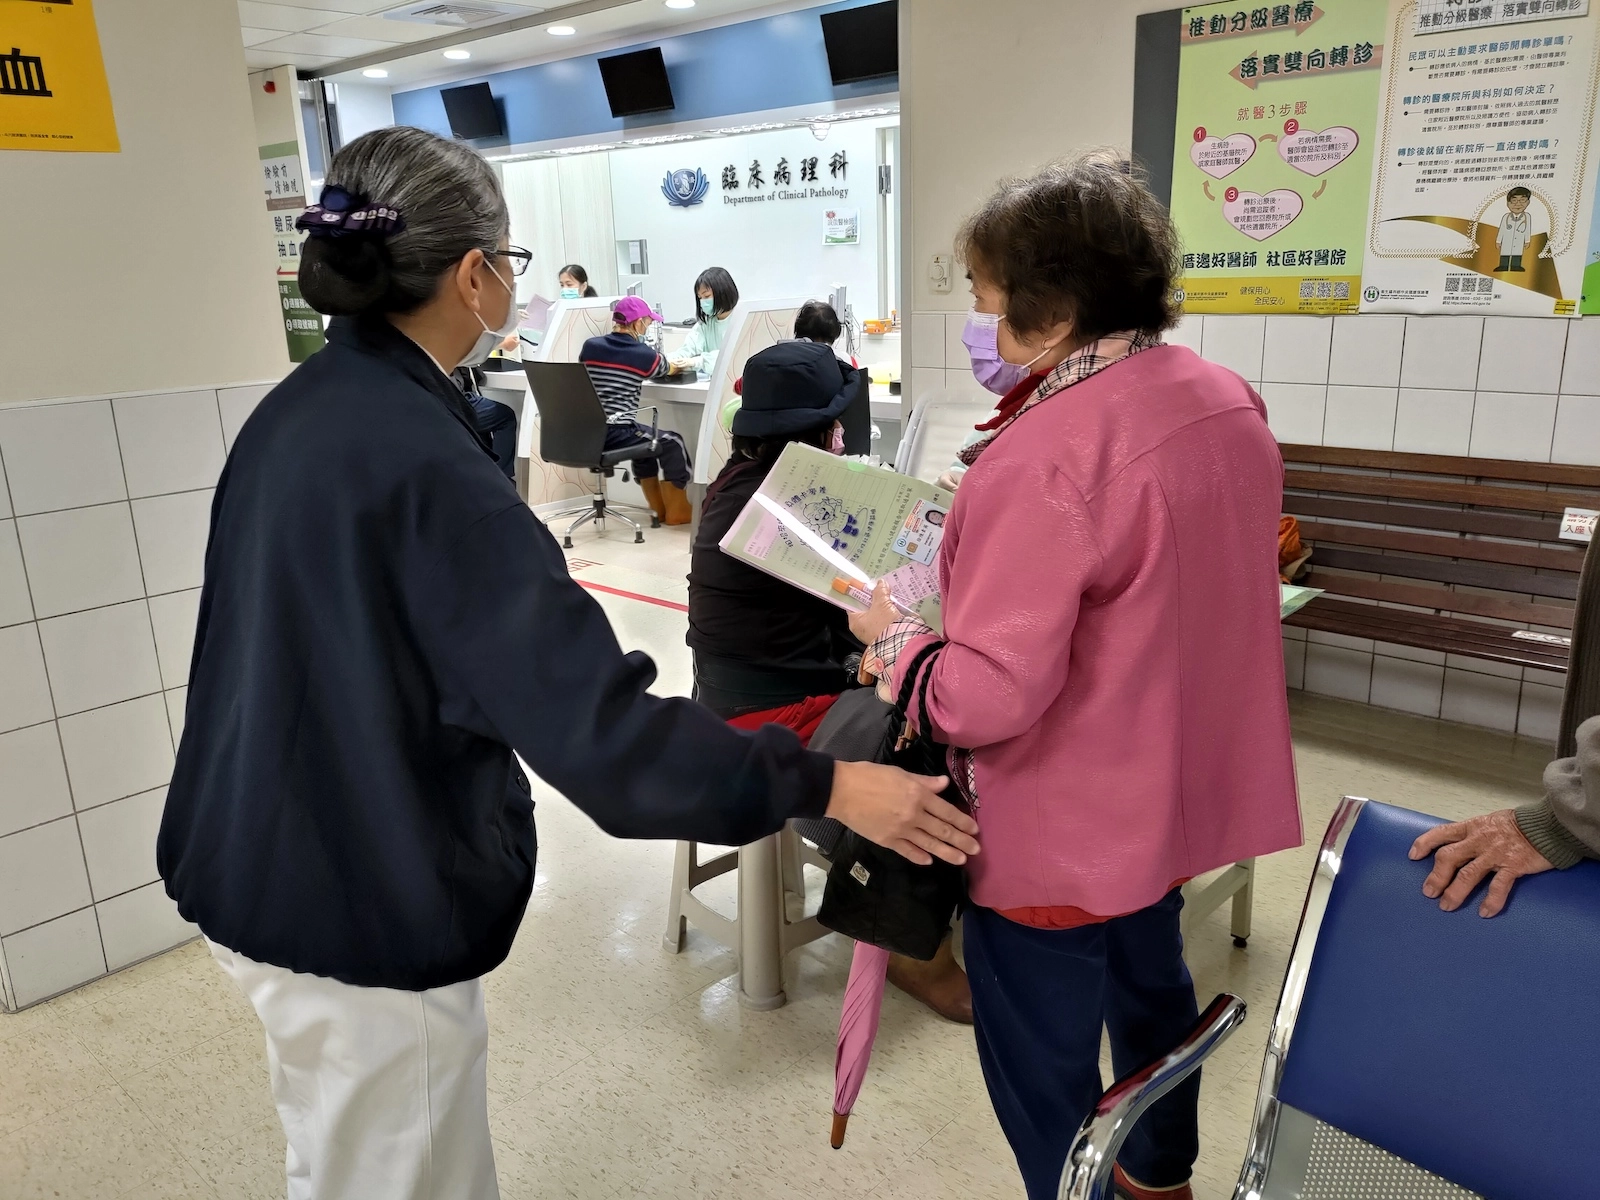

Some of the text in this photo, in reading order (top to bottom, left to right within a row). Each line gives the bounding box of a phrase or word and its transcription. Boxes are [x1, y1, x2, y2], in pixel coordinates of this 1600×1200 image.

[1189, 1, 1314, 37] 推動分級醫療
[1419, 0, 1581, 28] 推動分級醫療 落實雙向轉診
[1240, 42, 1373, 79] 落實雙向轉診
[0, 47, 53, 97] 血
[1237, 101, 1308, 121] 就醫3步驟
[1196, 129, 1203, 140] 1
[1287, 121, 1296, 132] 2
[722, 150, 849, 190] 臨床病理科
[724, 186, 849, 206] Department of Clinical Pathology
[1229, 189, 1236, 200] 3
[278, 241, 298, 257] 抽血
[1183, 249, 1347, 269] 厝邊好醫師 社區好醫院
[1240, 286, 1271, 295] 健保用心
[1254, 296, 1286, 306] 全民安心
[1564, 524, 1585, 535] 入座
